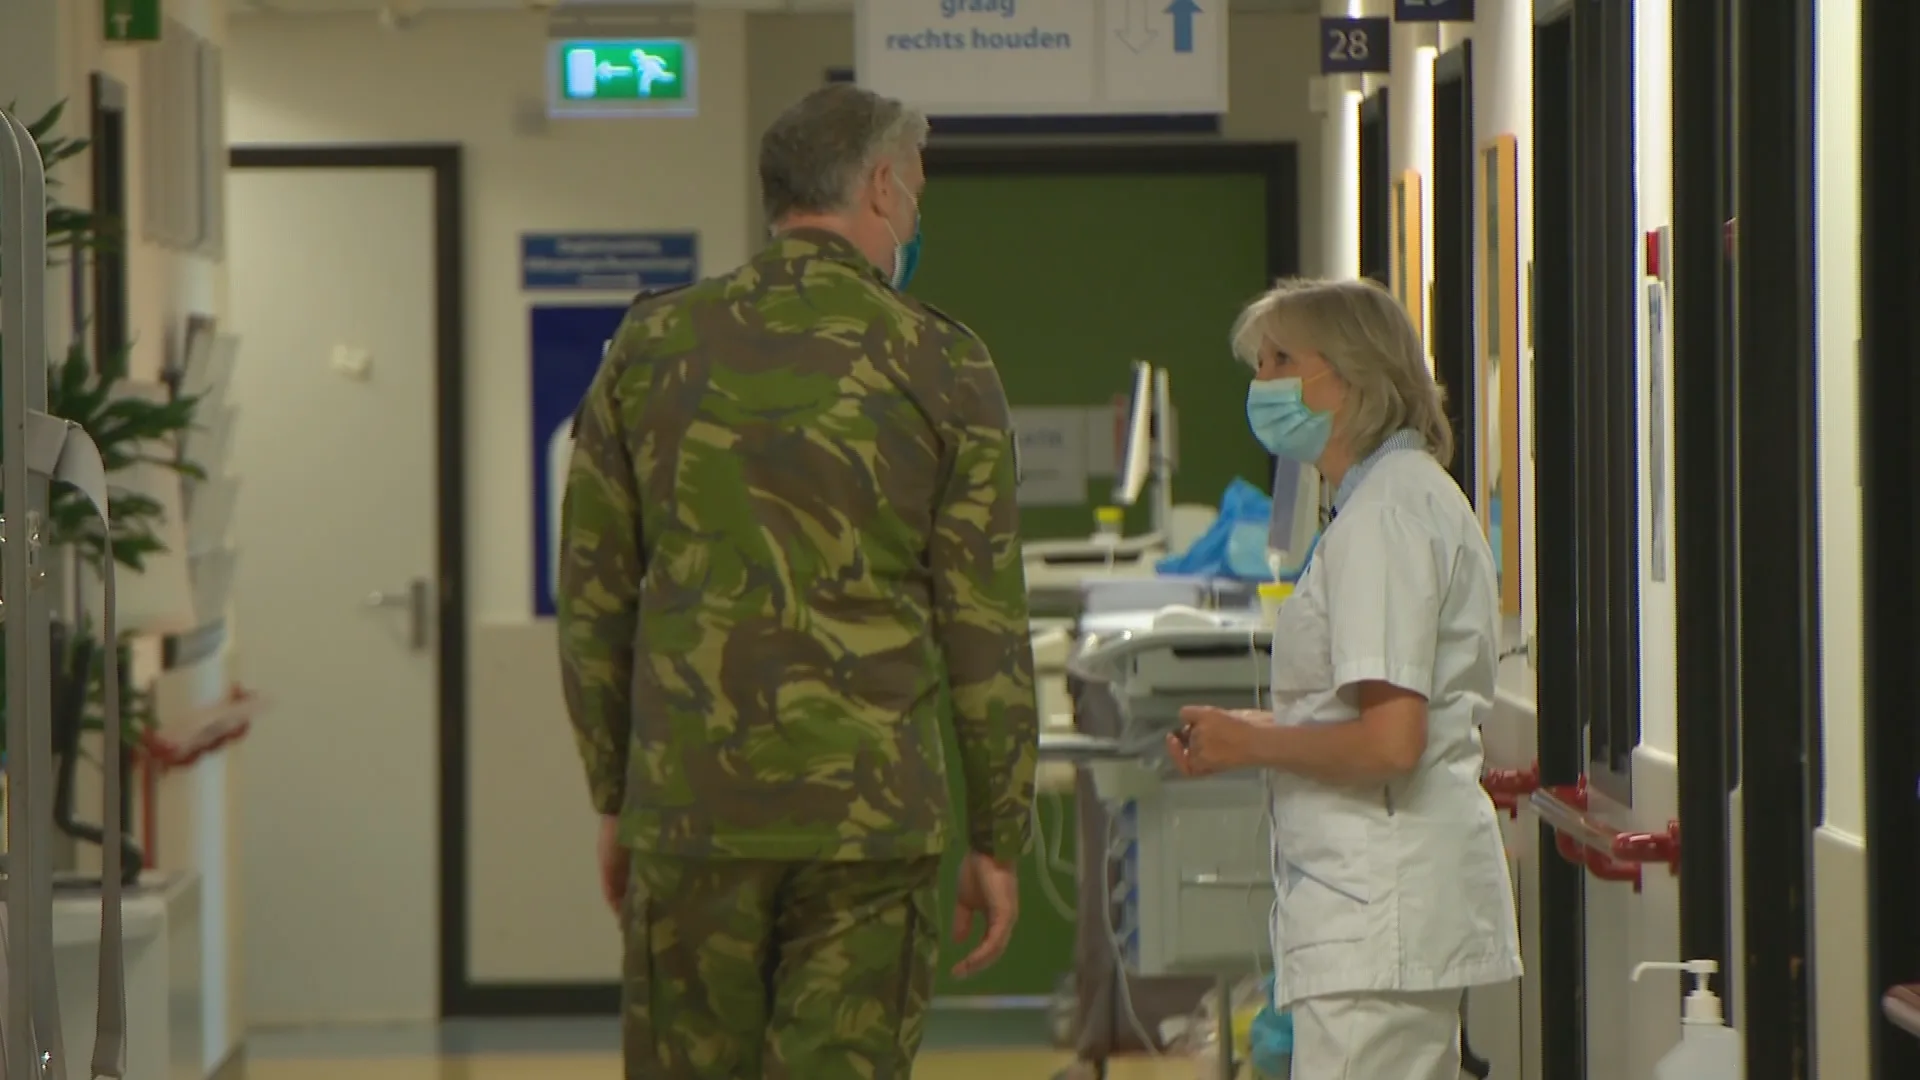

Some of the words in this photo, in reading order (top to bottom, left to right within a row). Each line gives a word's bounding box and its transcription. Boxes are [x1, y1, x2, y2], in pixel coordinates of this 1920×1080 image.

[941, 0, 1016, 18] graag
[886, 28, 965, 49] rechts
[971, 27, 1071, 49] houden
[1328, 28, 1369, 61] 28
